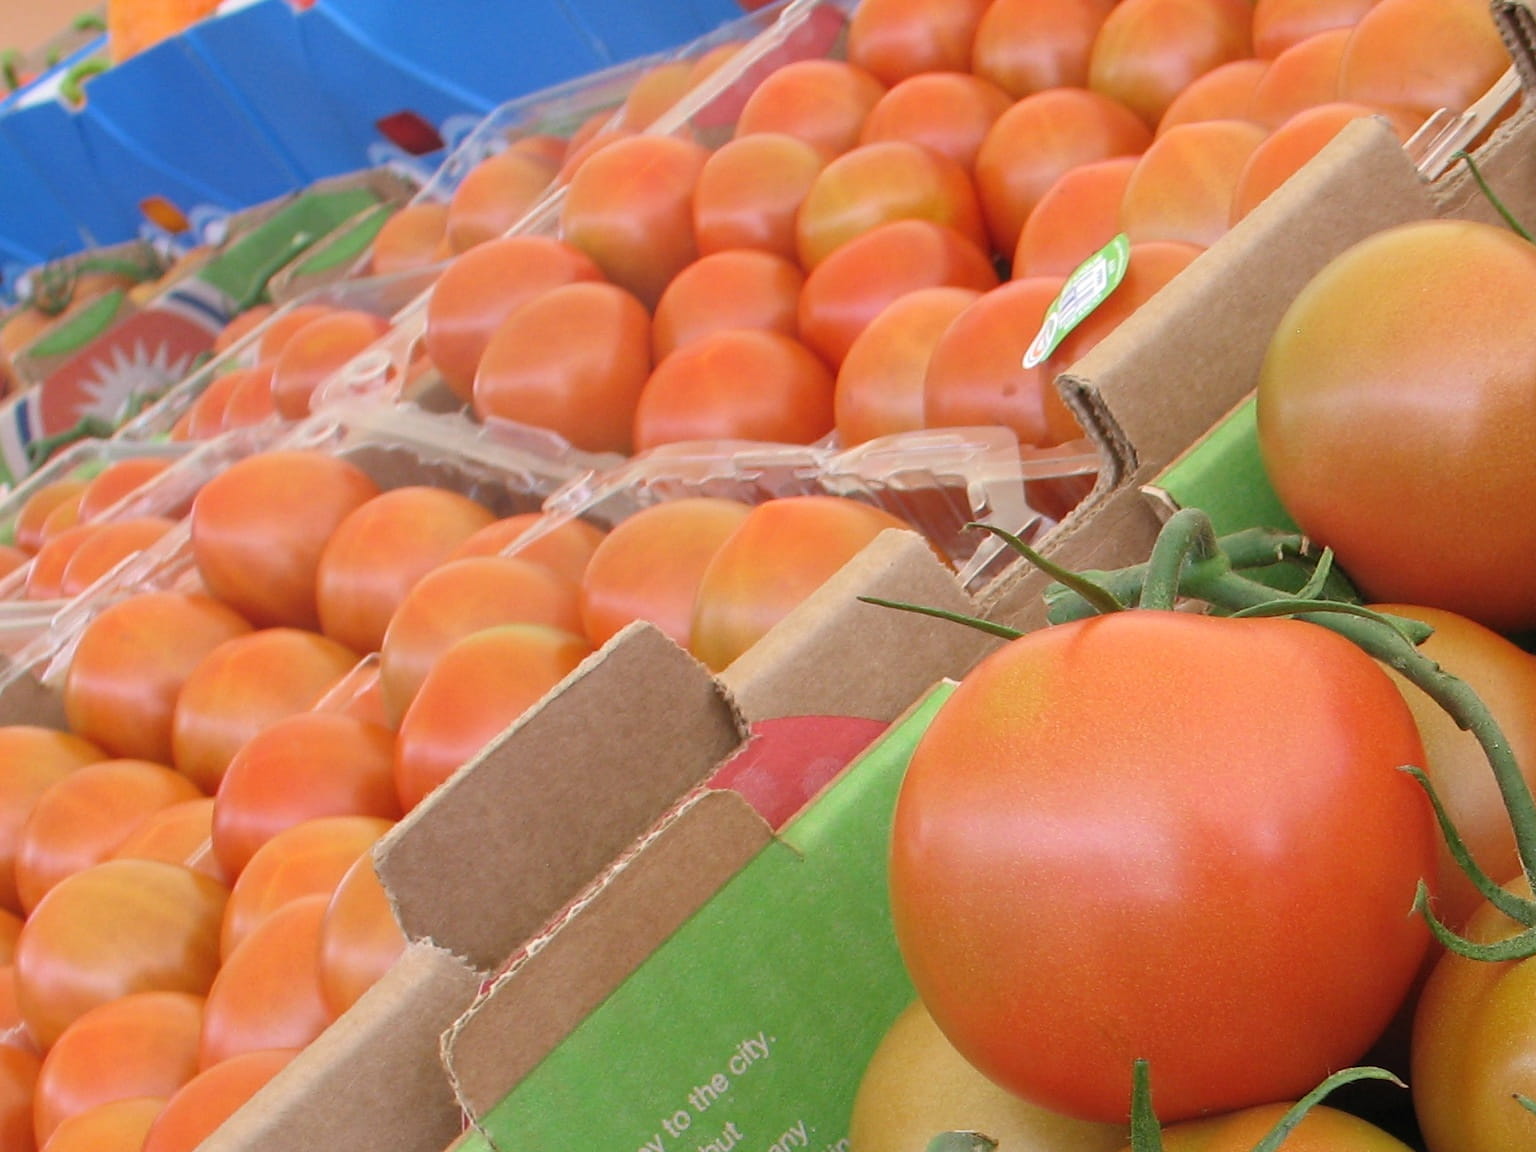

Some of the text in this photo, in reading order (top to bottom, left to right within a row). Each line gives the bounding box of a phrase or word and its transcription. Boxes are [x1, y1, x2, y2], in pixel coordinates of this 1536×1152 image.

[662, 1110, 692, 1138] to
[688, 1073, 730, 1112] the
[729, 1031, 777, 1075] city.
